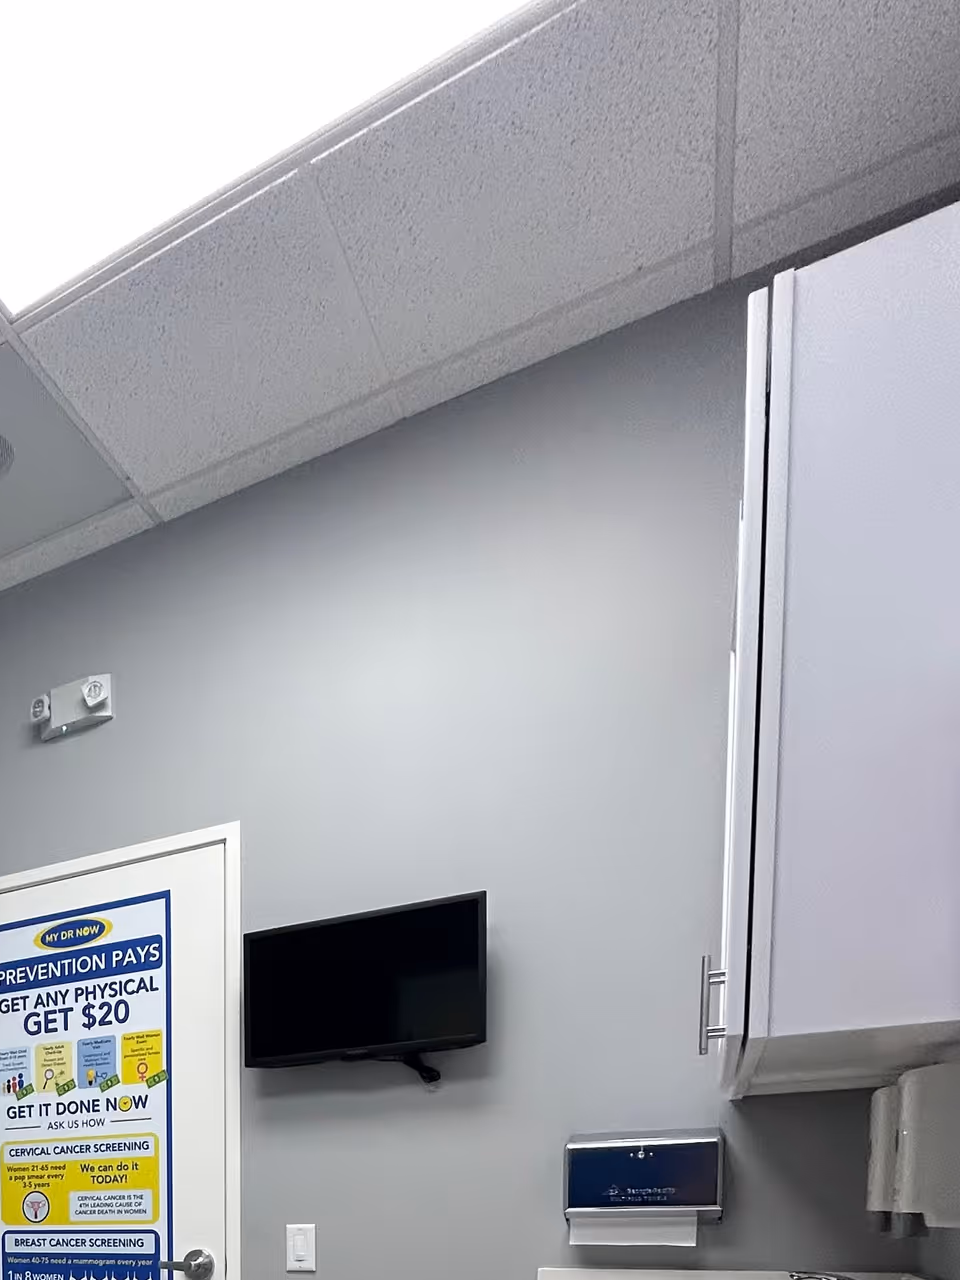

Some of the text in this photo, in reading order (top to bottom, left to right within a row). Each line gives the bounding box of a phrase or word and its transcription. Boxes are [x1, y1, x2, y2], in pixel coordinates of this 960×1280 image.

[45, 924, 100, 944] MY DR NOW
[112, 943, 160, 968] PAYS
[33, 989, 70, 1009] ANY
[74, 975, 159, 1003] PHYSICAL
[23, 999, 130, 1036] GET $20
[6, 1094, 149, 1120] GET IT DONE NOW
[47, 1118, 106, 1131] ASK US HOW
[9, 1140, 150, 1158] CERVICAL CANCER SCREENING
[6, 1163, 66, 1173] Women 21-65 need
[80, 1163, 95, 1173] We
[116, 1161, 129, 1171] do
[131, 1161, 139, 1171] it
[14, 1175, 26, 1183] pap
[46, 1173, 65, 1181] every
[90, 1174, 128, 1185] TODAY!
[22, 1181, 50, 1189] 3-5 years
[14, 1238, 145, 1248] BREAST CANCER SCREENING
[7, 1256, 31, 1264] Women
[31, 1256, 49, 1264] 40-75
[50, 1257, 67, 1265] need
[73, 1258, 115, 1267] mammogram
[14, 1273, 23, 1280] IN
